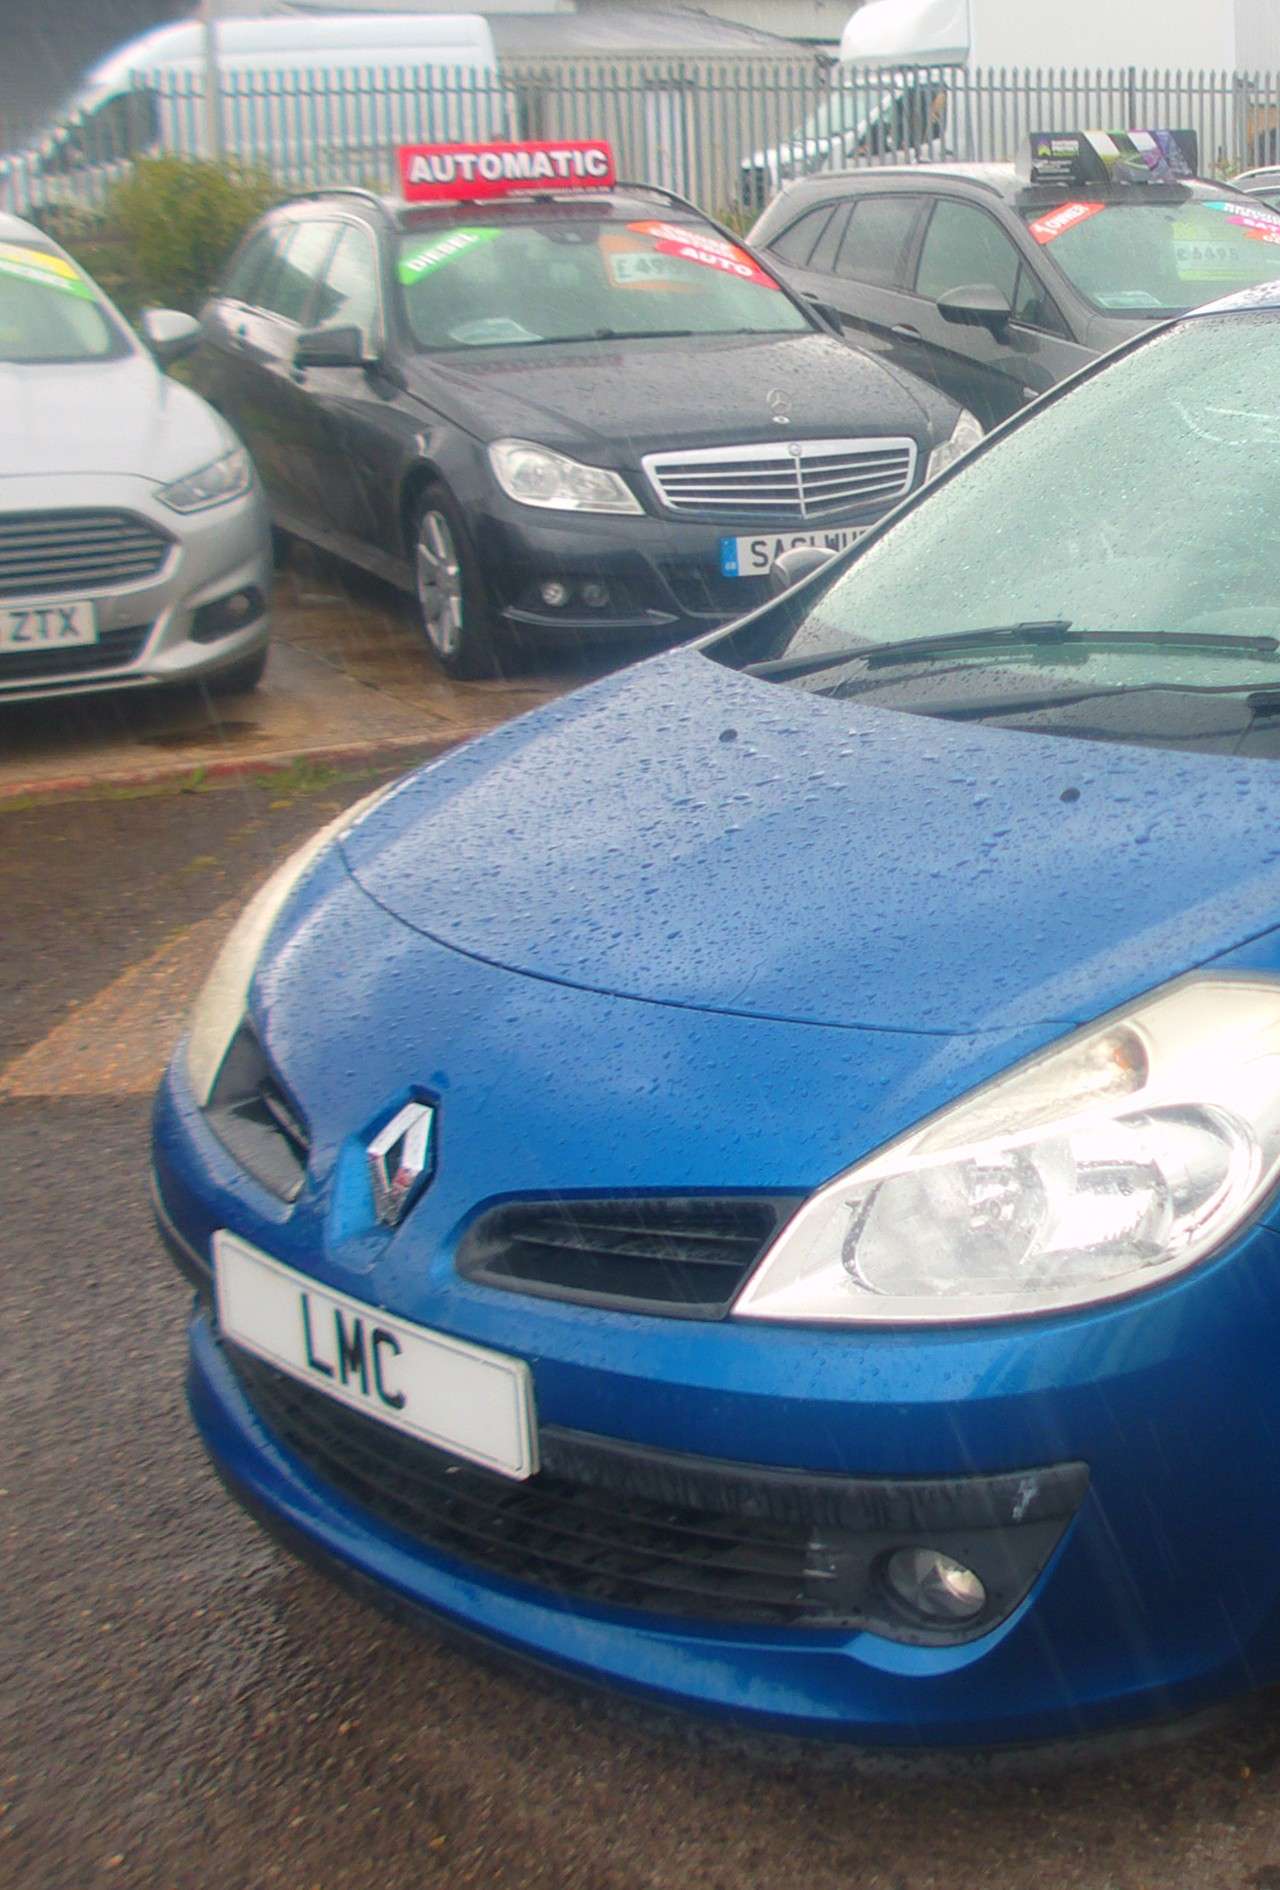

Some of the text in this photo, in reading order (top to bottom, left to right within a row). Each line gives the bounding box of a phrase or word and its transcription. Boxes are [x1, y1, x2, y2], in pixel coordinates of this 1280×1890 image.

[409, 149, 609, 183] AUTOMATIC
[679, 247, 753, 276] AUTO
[9, 606, 80, 641] ZTX
[302, 1292, 405, 1411] LMC
